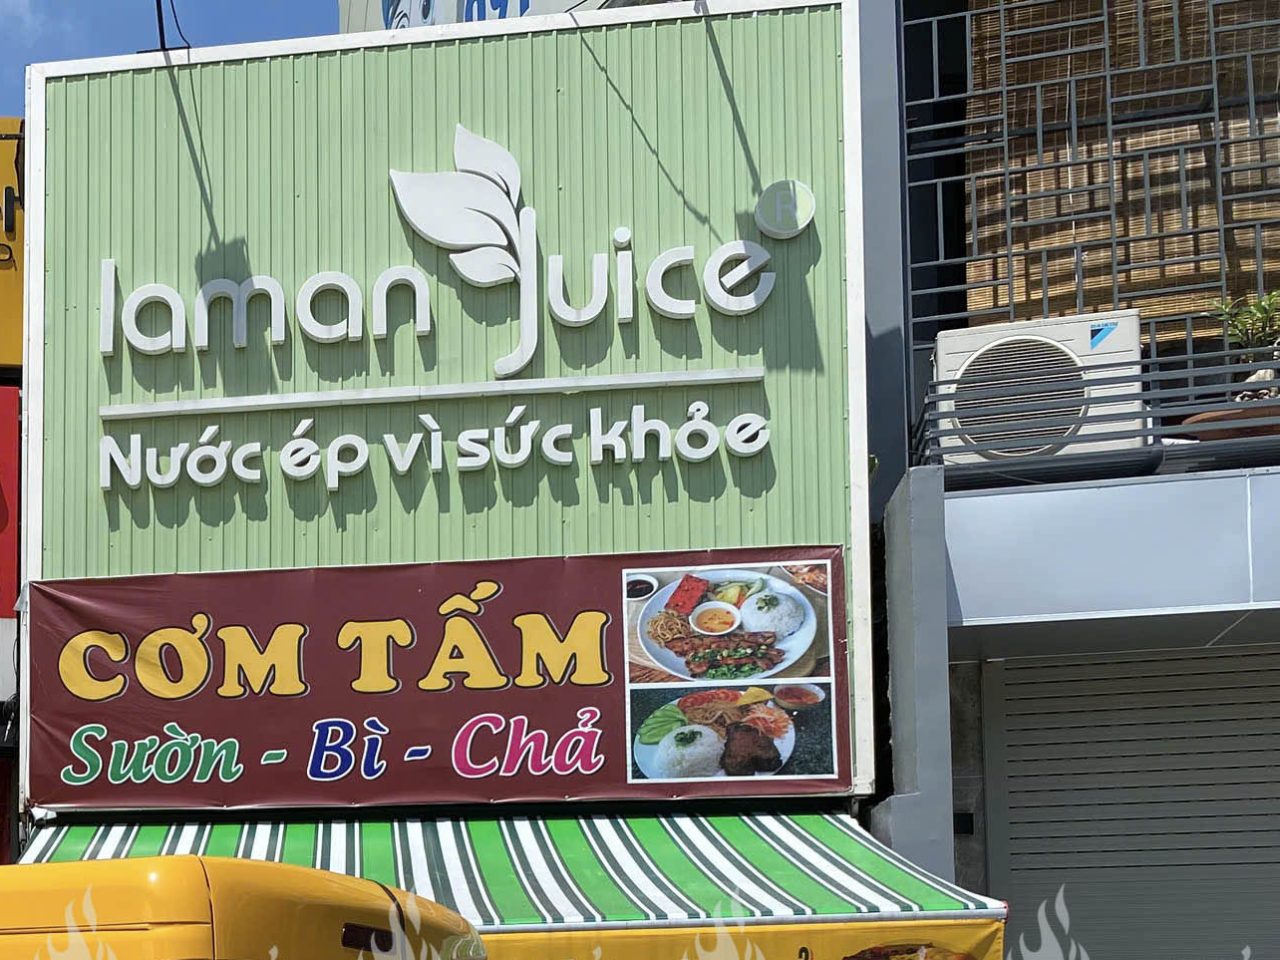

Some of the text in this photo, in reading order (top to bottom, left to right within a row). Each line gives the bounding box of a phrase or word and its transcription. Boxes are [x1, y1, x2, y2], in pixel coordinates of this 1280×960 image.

[100, 400, 770, 492] Nước ép vì sức khỏe
[58, 580, 613, 702] CƠM TẤM
[60, 705, 606, 787] Sườn - Bì - Chả
